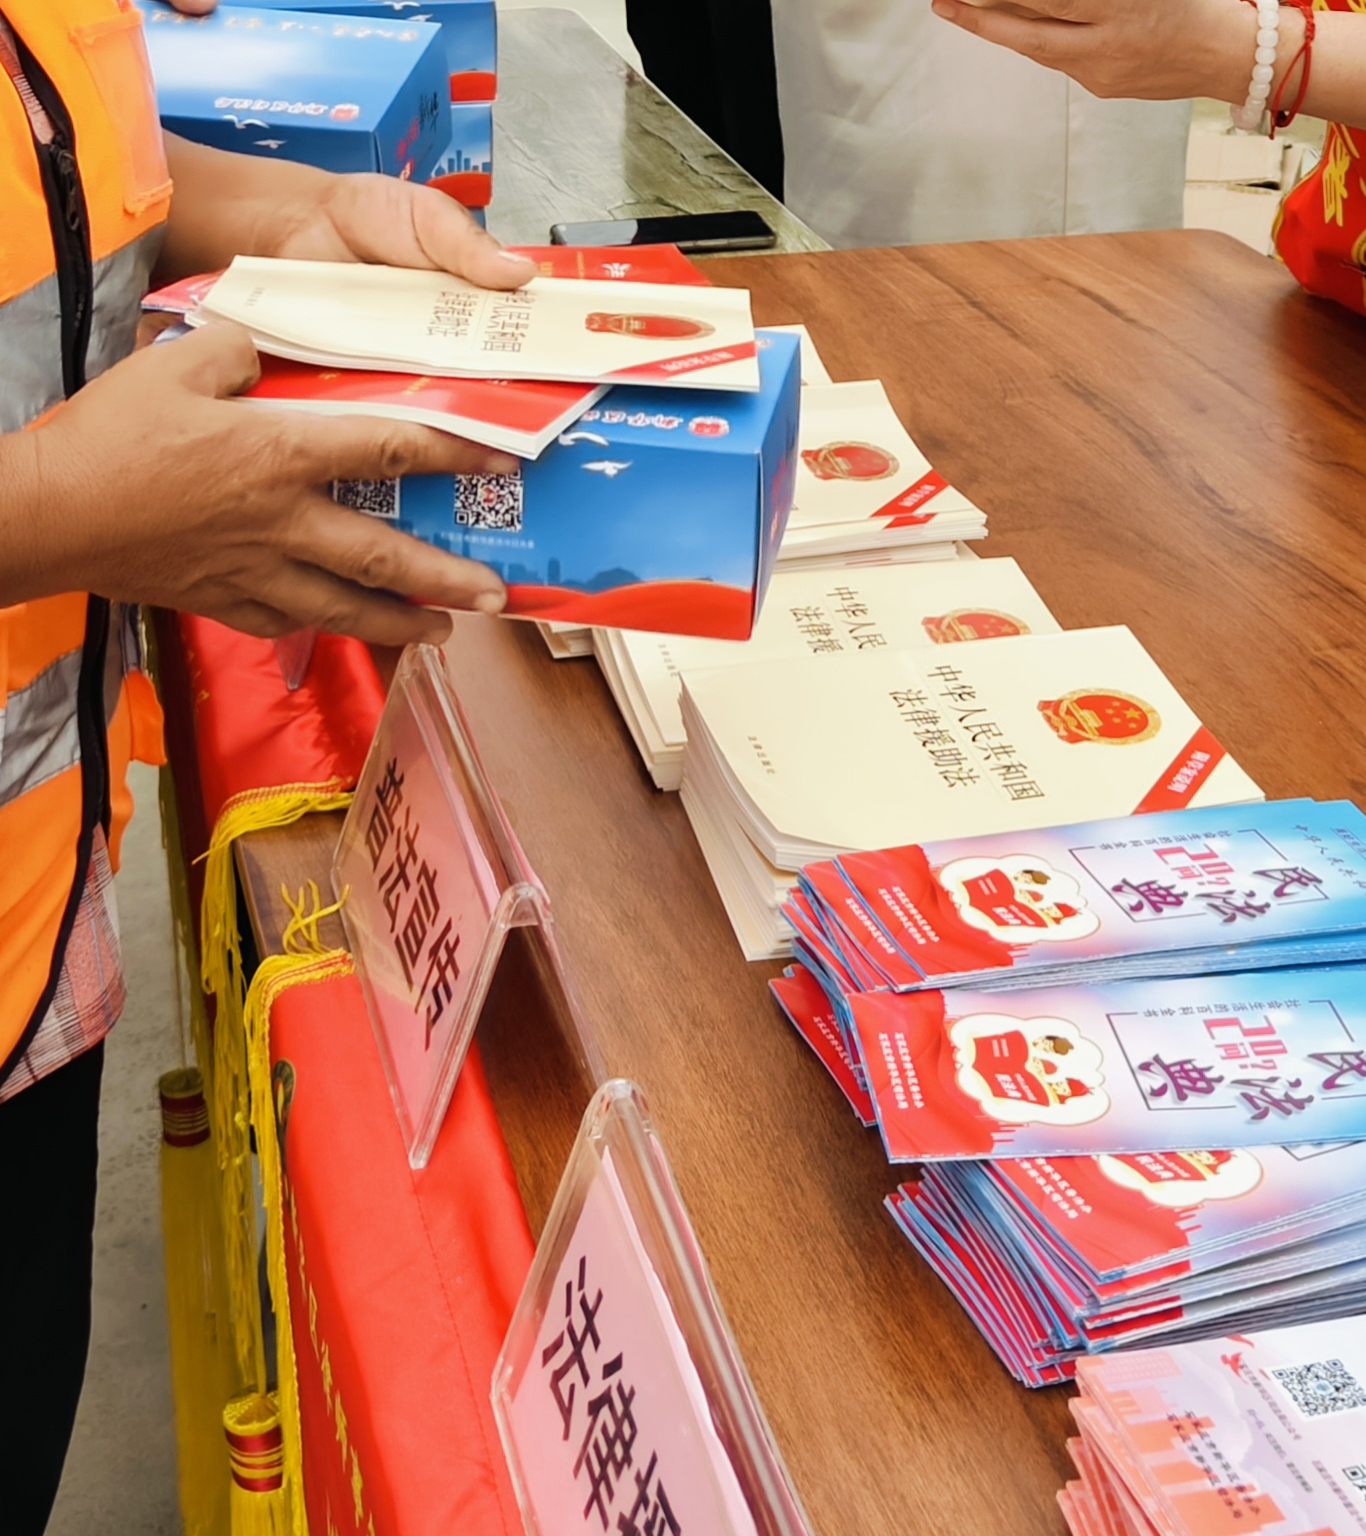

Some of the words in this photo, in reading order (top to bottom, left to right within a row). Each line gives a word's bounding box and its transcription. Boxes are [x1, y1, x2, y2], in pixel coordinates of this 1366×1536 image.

[888, 688, 981, 789] 法律援助法
[925, 664, 1045, 803] 中华人民共和国
[363, 756, 462, 1054] 普法宣传
[1142, 997, 1303, 1018] 社会生活的百科全书
